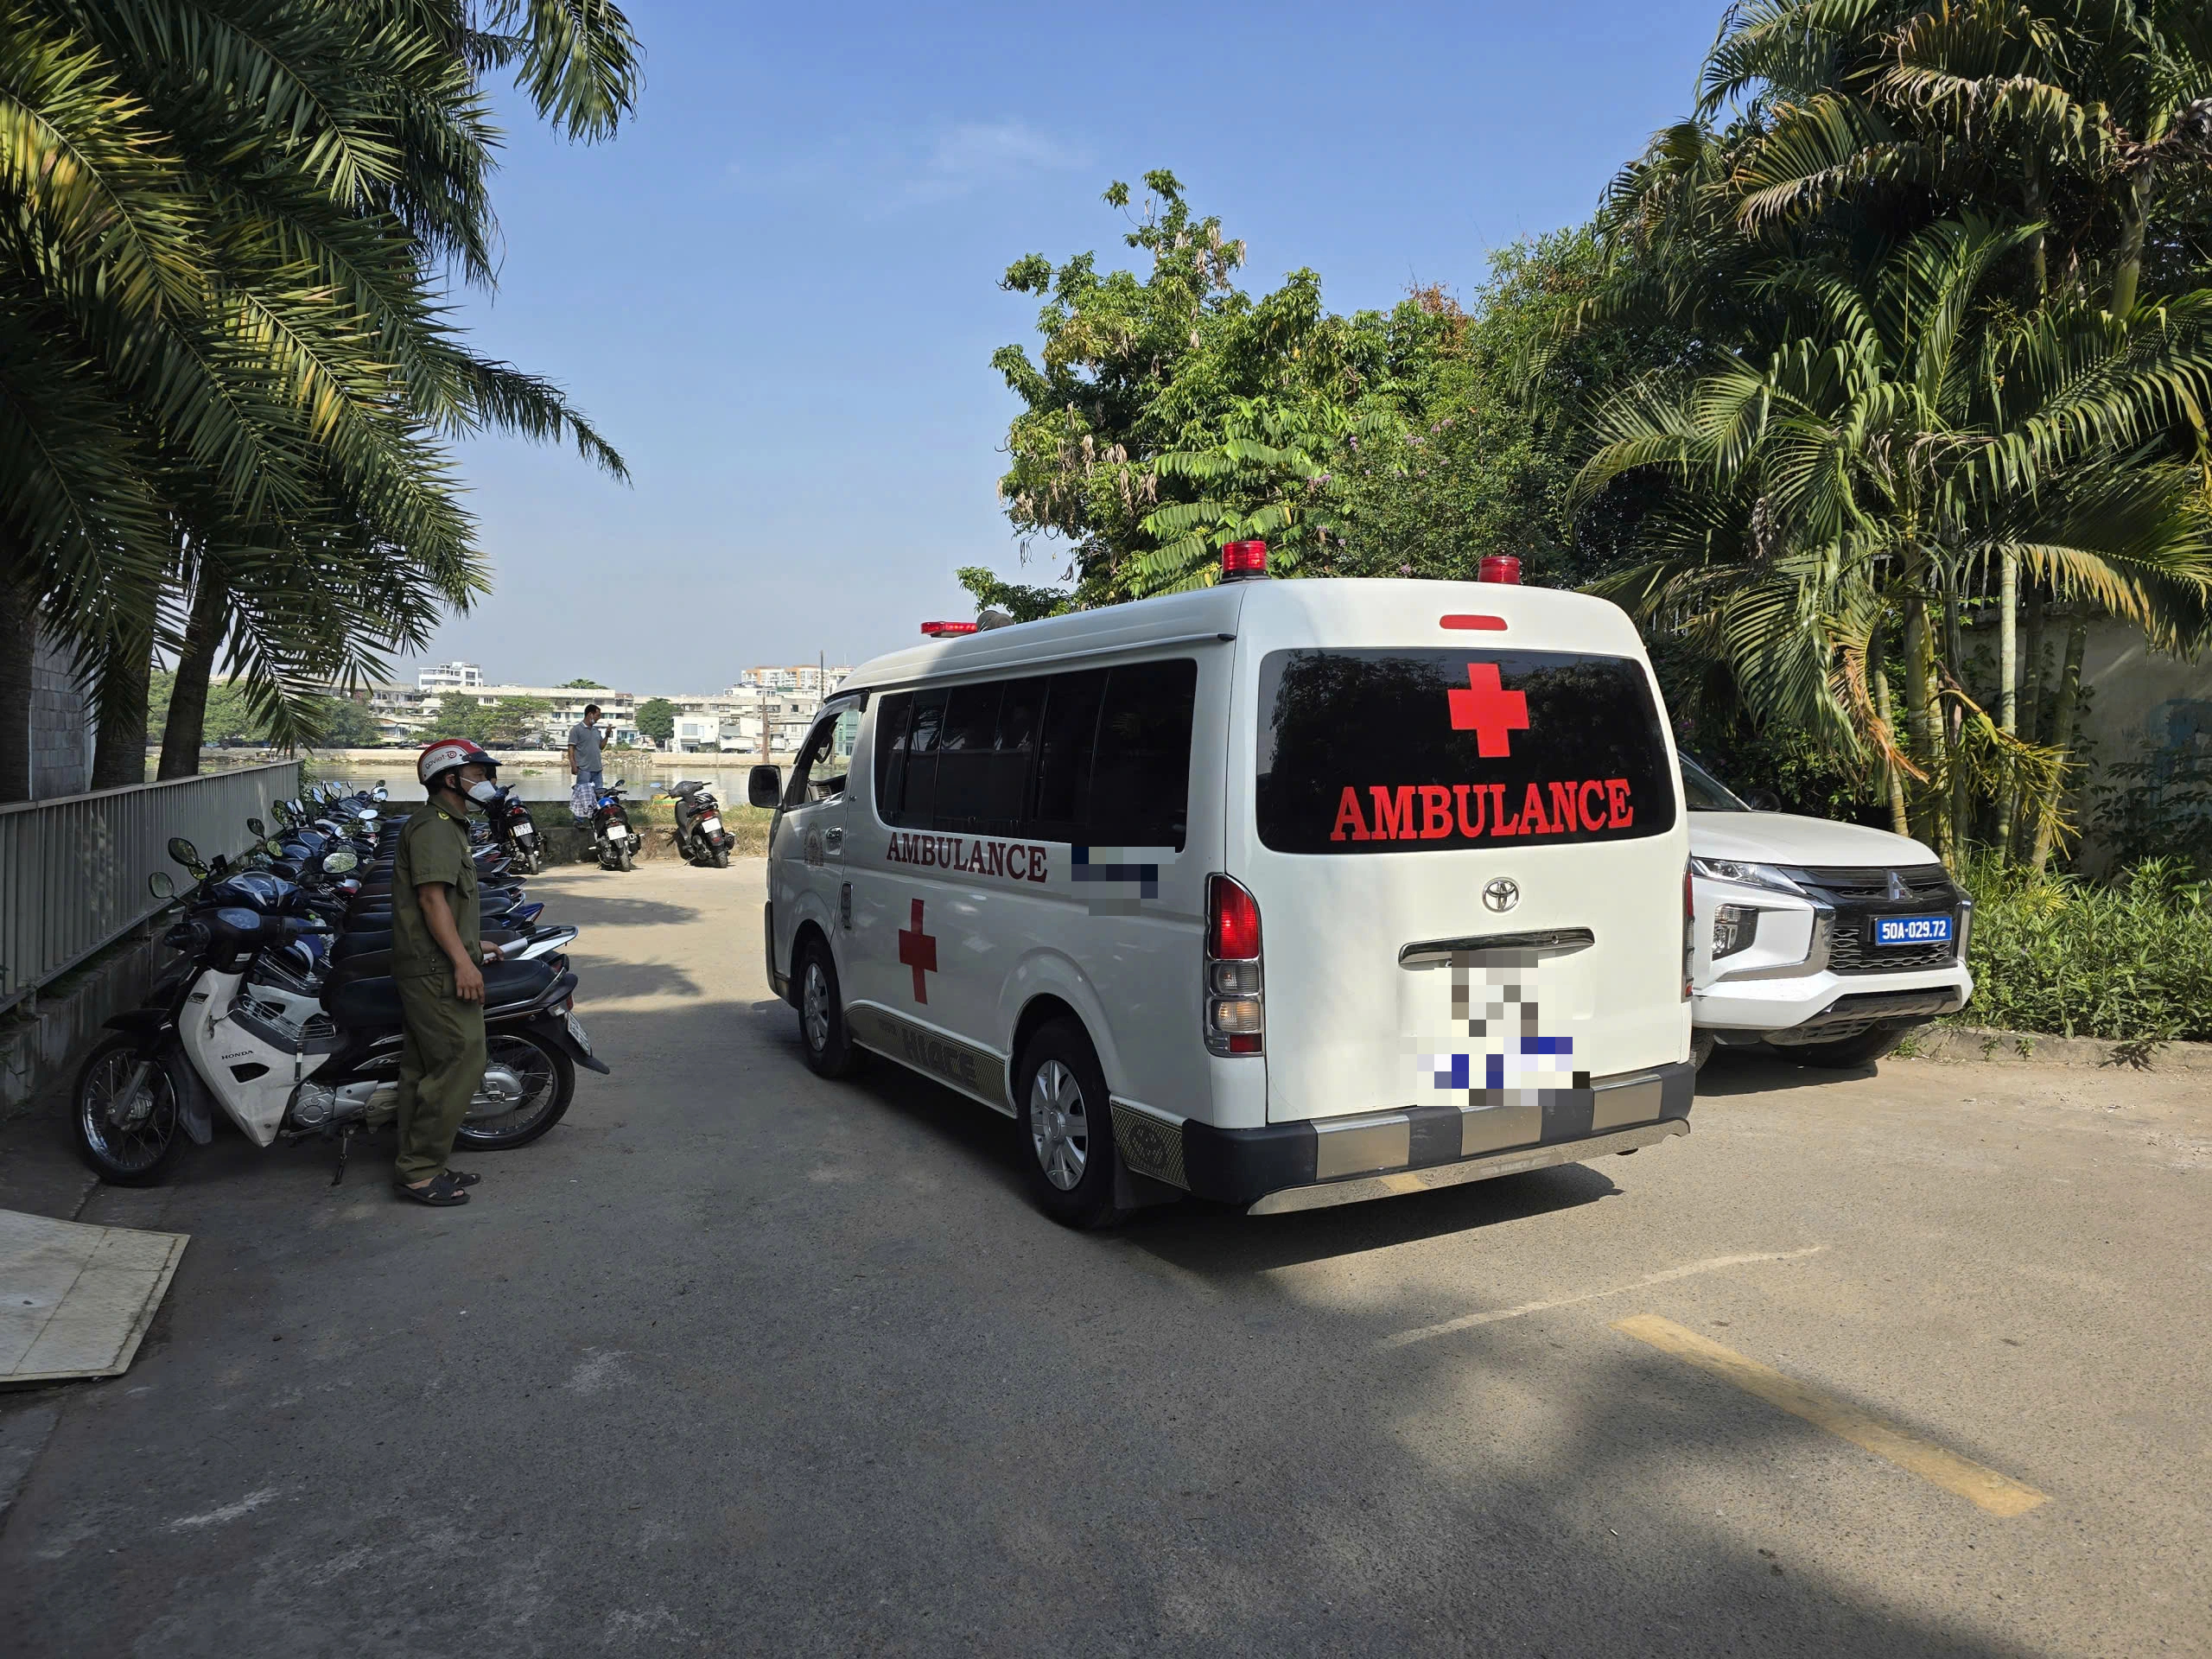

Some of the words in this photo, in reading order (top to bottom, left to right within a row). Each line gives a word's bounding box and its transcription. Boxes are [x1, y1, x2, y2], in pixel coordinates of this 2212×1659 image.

[1330, 779, 1634, 841] AMBULANCE
[887, 832, 1048, 883] AMBULANCE
[1882, 920, 1946, 939] 50A-029.72
[221, 1050, 254, 1059] HONDA
